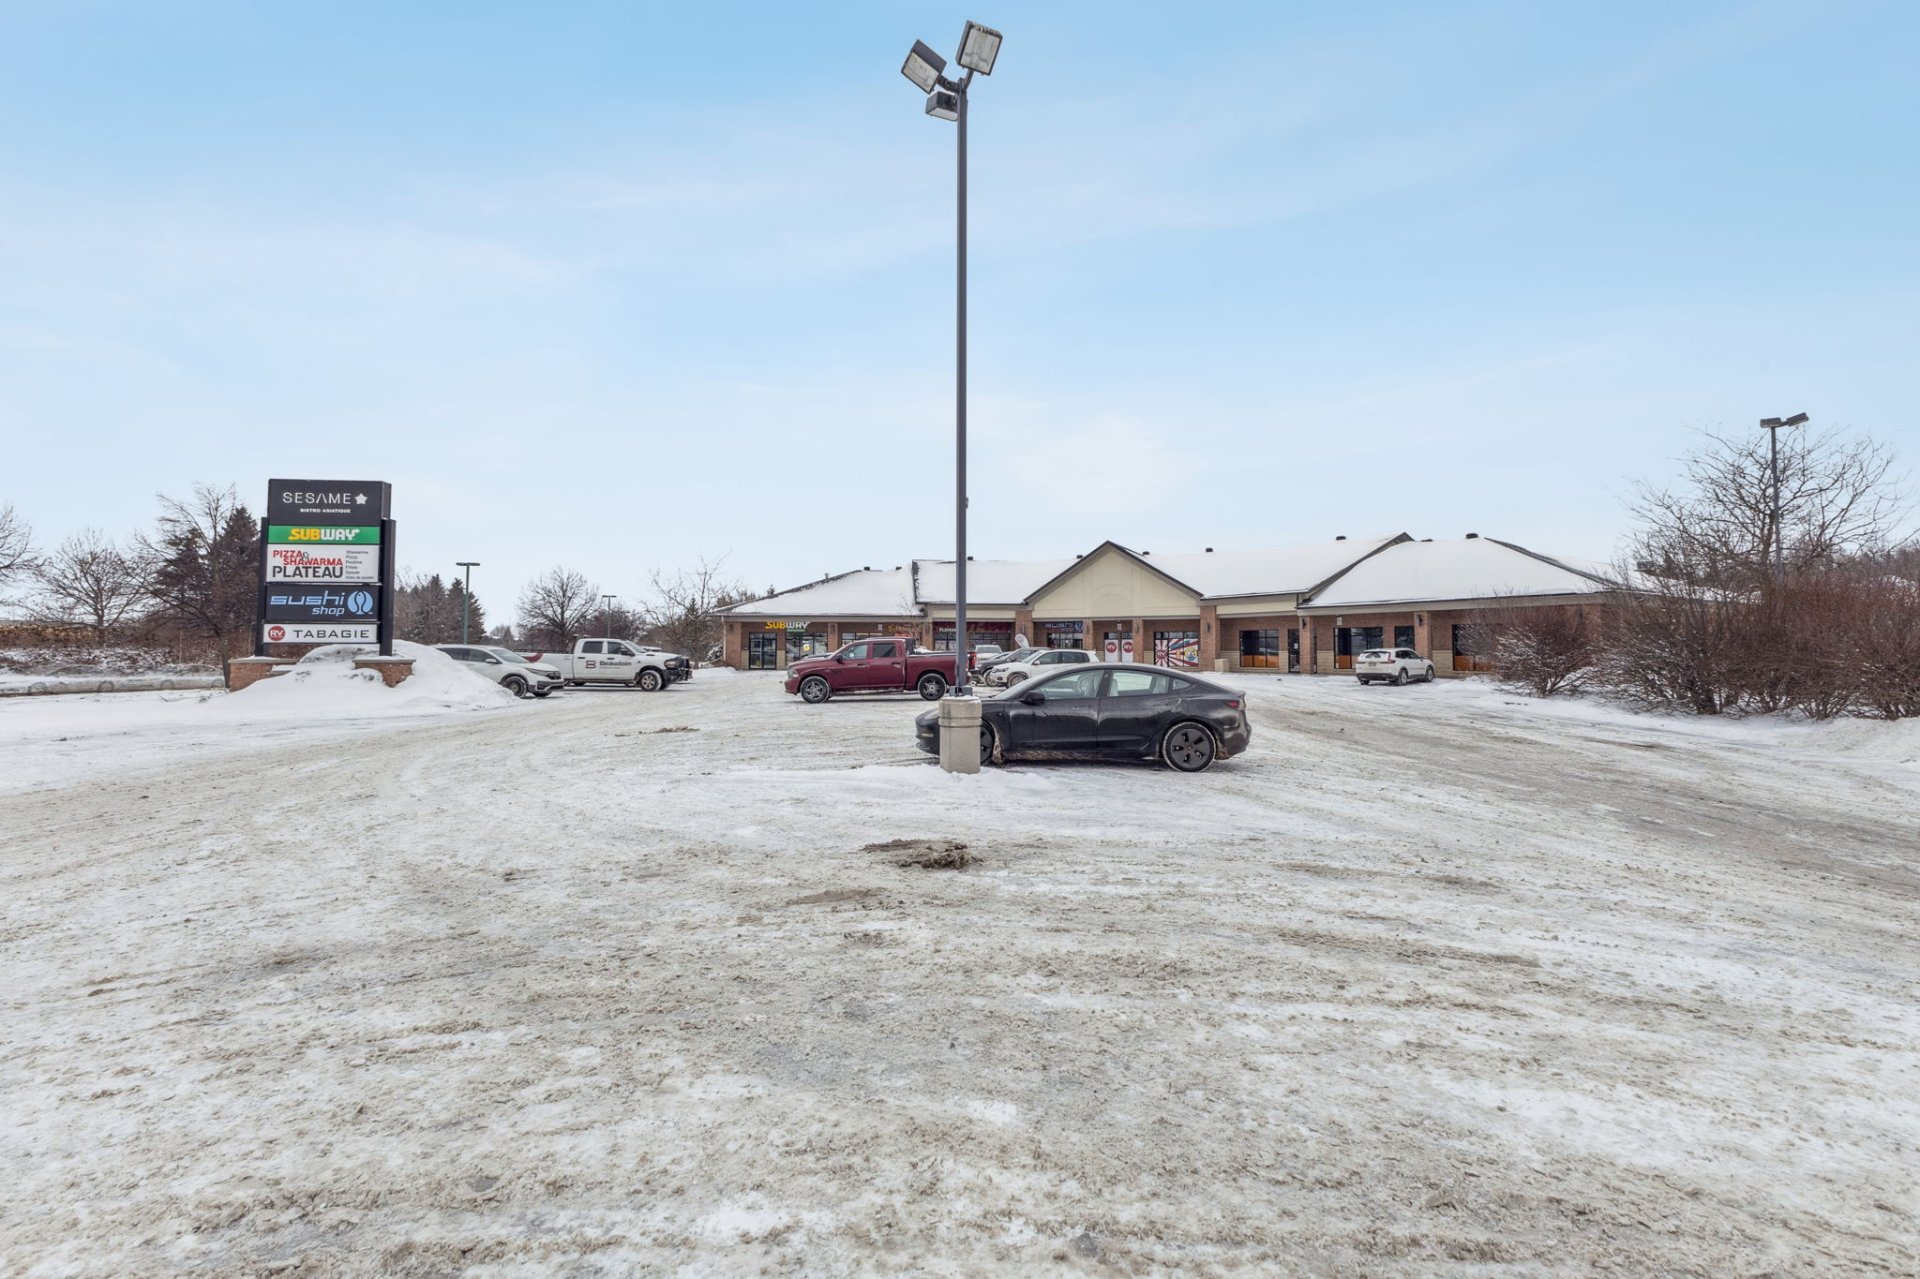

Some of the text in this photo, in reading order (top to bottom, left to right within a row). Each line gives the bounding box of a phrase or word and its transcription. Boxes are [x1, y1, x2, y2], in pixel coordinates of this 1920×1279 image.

[282, 492, 352, 505] SESAME
[288, 528, 361, 541] SUBWAY
[272, 550, 303, 558] PIZZA
[283, 557, 343, 566] SHAWARMA
[272, 566, 344, 578] PLATEAU
[270, 590, 345, 605] sushi
[312, 606, 345, 617] shop
[765, 621, 811, 629] SUBWAY
[269, 629, 370, 639] RV TABAGIE
